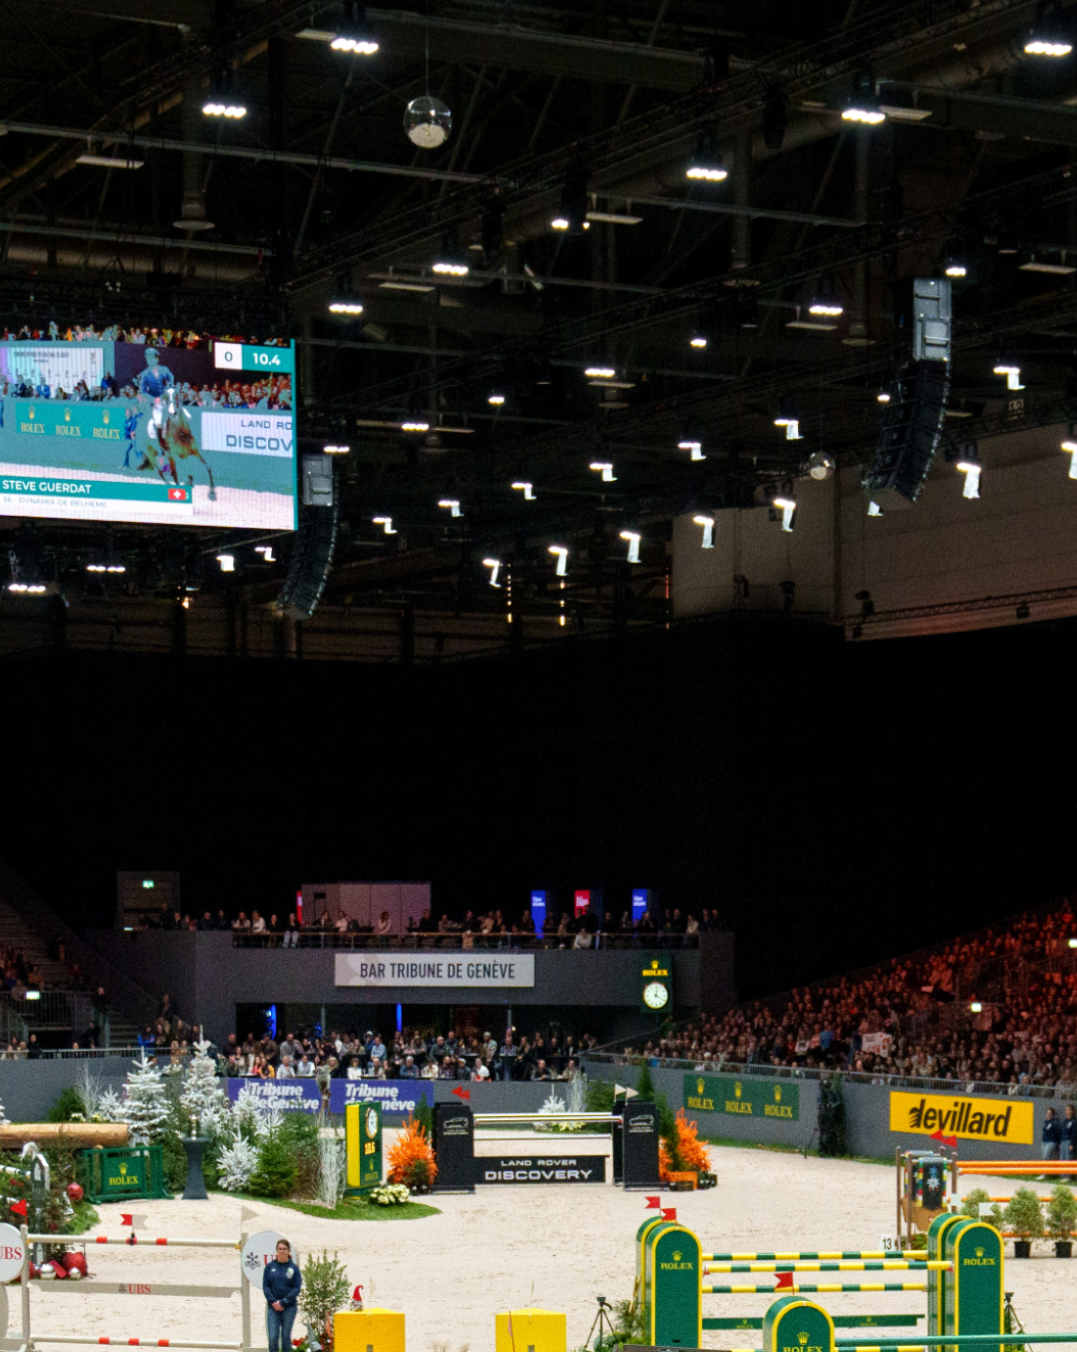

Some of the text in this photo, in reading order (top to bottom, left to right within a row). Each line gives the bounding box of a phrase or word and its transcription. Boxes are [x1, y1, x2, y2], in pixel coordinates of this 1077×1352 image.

[253, 353, 280, 366] 10.4
[21, 422, 45, 434] ROLEX
[55, 425, 81, 436] ROLEX
[241, 420, 270, 429] LAND
[93, 427, 120, 439] ROLEX
[2, 480, 91, 494] STEVE GUERDAT
[360, 959, 515, 978] BAR TRIBUNE DE GENÈVE
[250, 1082, 303, 1096] Tribune
[346, 1083, 399, 1097] Tribune
[688, 1097, 714, 1110] ROLEX
[725, 1101, 752, 1114] ROLEX
[764, 1104, 792, 1118] ROLEX
[909, 1099, 1012, 1137] devillard
[109, 1176, 139, 1186] ROLEX
[485, 1170, 592, 1180] DISCOVERY
[883, 1237, 892, 1250] 13
[661, 1262, 693, 1270] ROLEX
[964, 1258, 995, 1266] ROLEX
[128, 1284, 151, 1294] UBS
